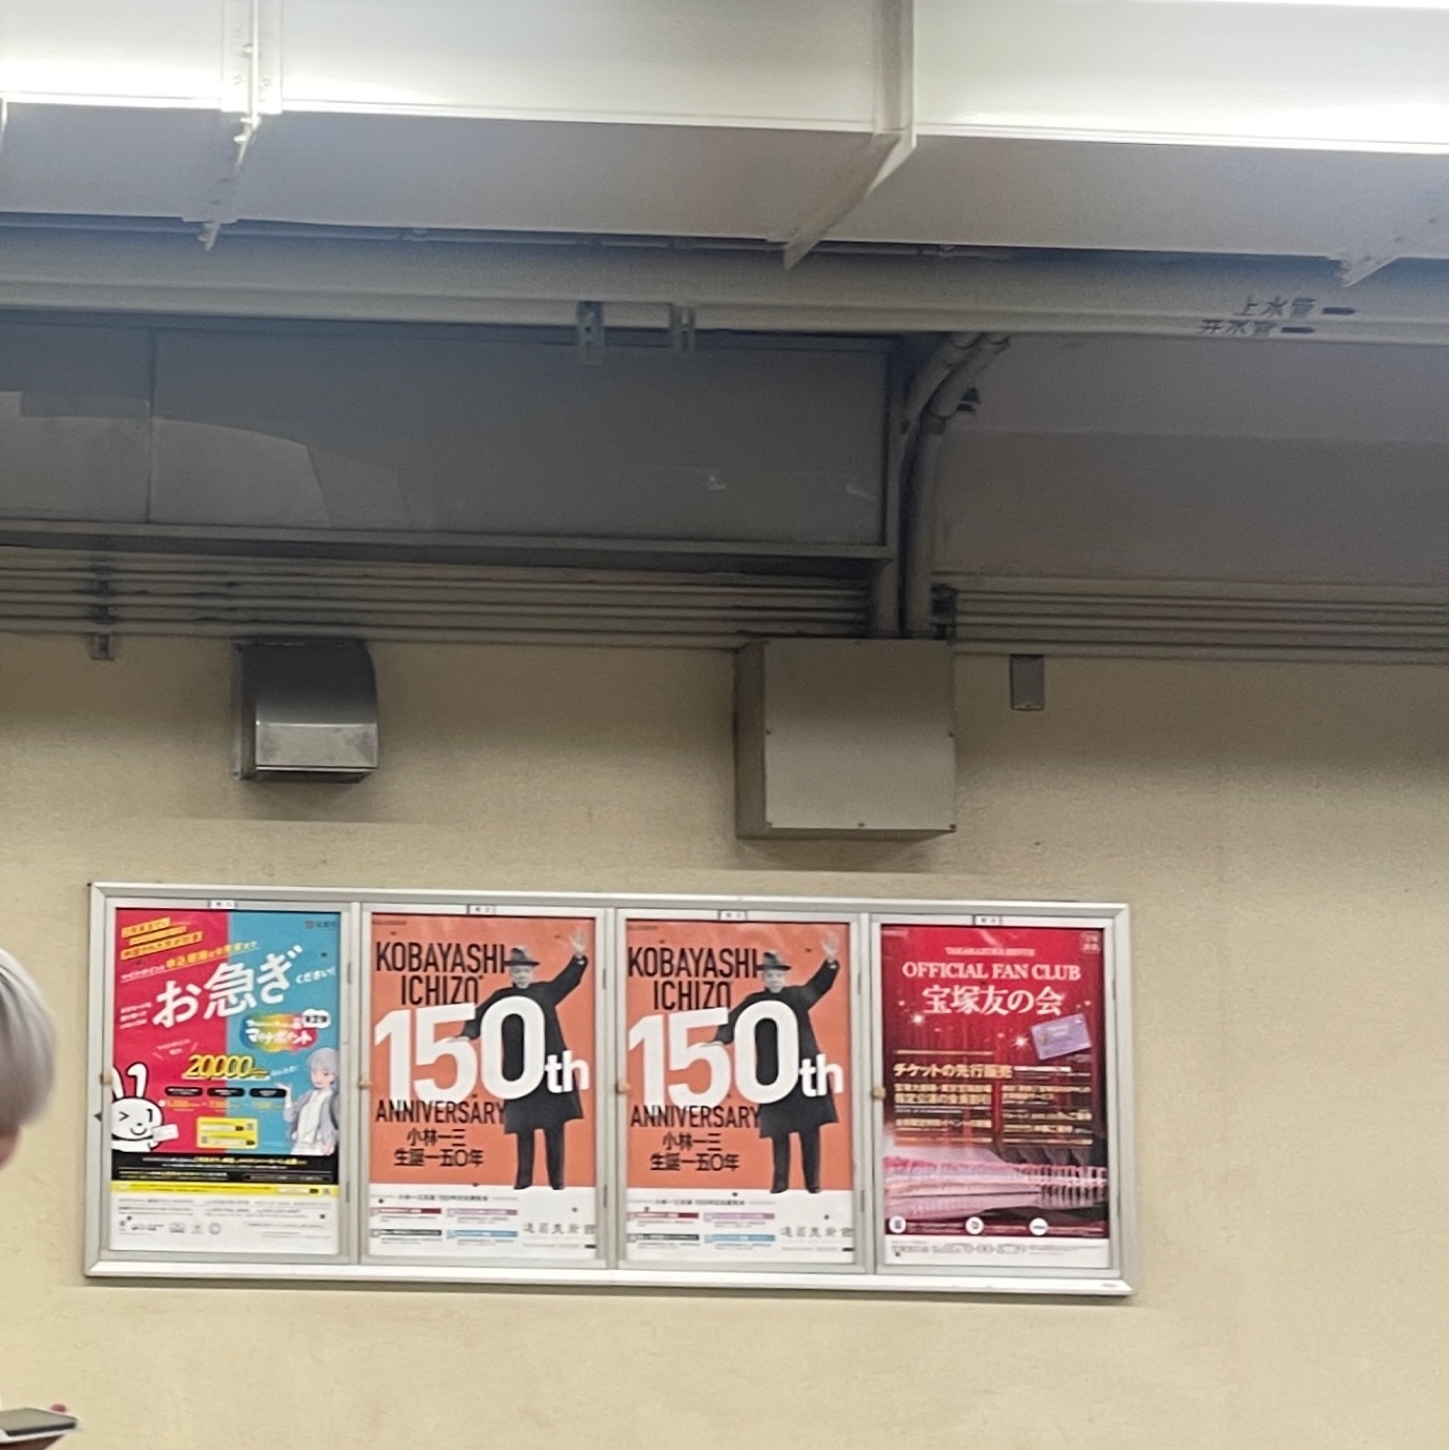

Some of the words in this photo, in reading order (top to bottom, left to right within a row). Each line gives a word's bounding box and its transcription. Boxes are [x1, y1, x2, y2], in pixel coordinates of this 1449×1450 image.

[376, 942, 505, 974] KOBAYASHI
[628, 947, 758, 978] KOBAYASHI
[902, 961, 988, 979] OFFICIAL
[992, 963, 1029, 980] FAN
[1031, 964, 1082, 981] CLUB
[152, 944, 303, 1028] お急ぎ
[401, 975, 479, 1006] ICHIZO
[654, 981, 731, 1010] ICHIZO
[922, 984, 1065, 1016] 宝塚友の会
[374, 995, 590, 1111] 150th
[628, 1000, 843, 1113] 150th
[375, 1100, 505, 1125] ANNIVERSARY
[630, 1105, 760, 1128] ANNIVERSARY
[407, 1128, 466, 1147] 小林一三
[662, 1132, 721, 1151] 小林一三
